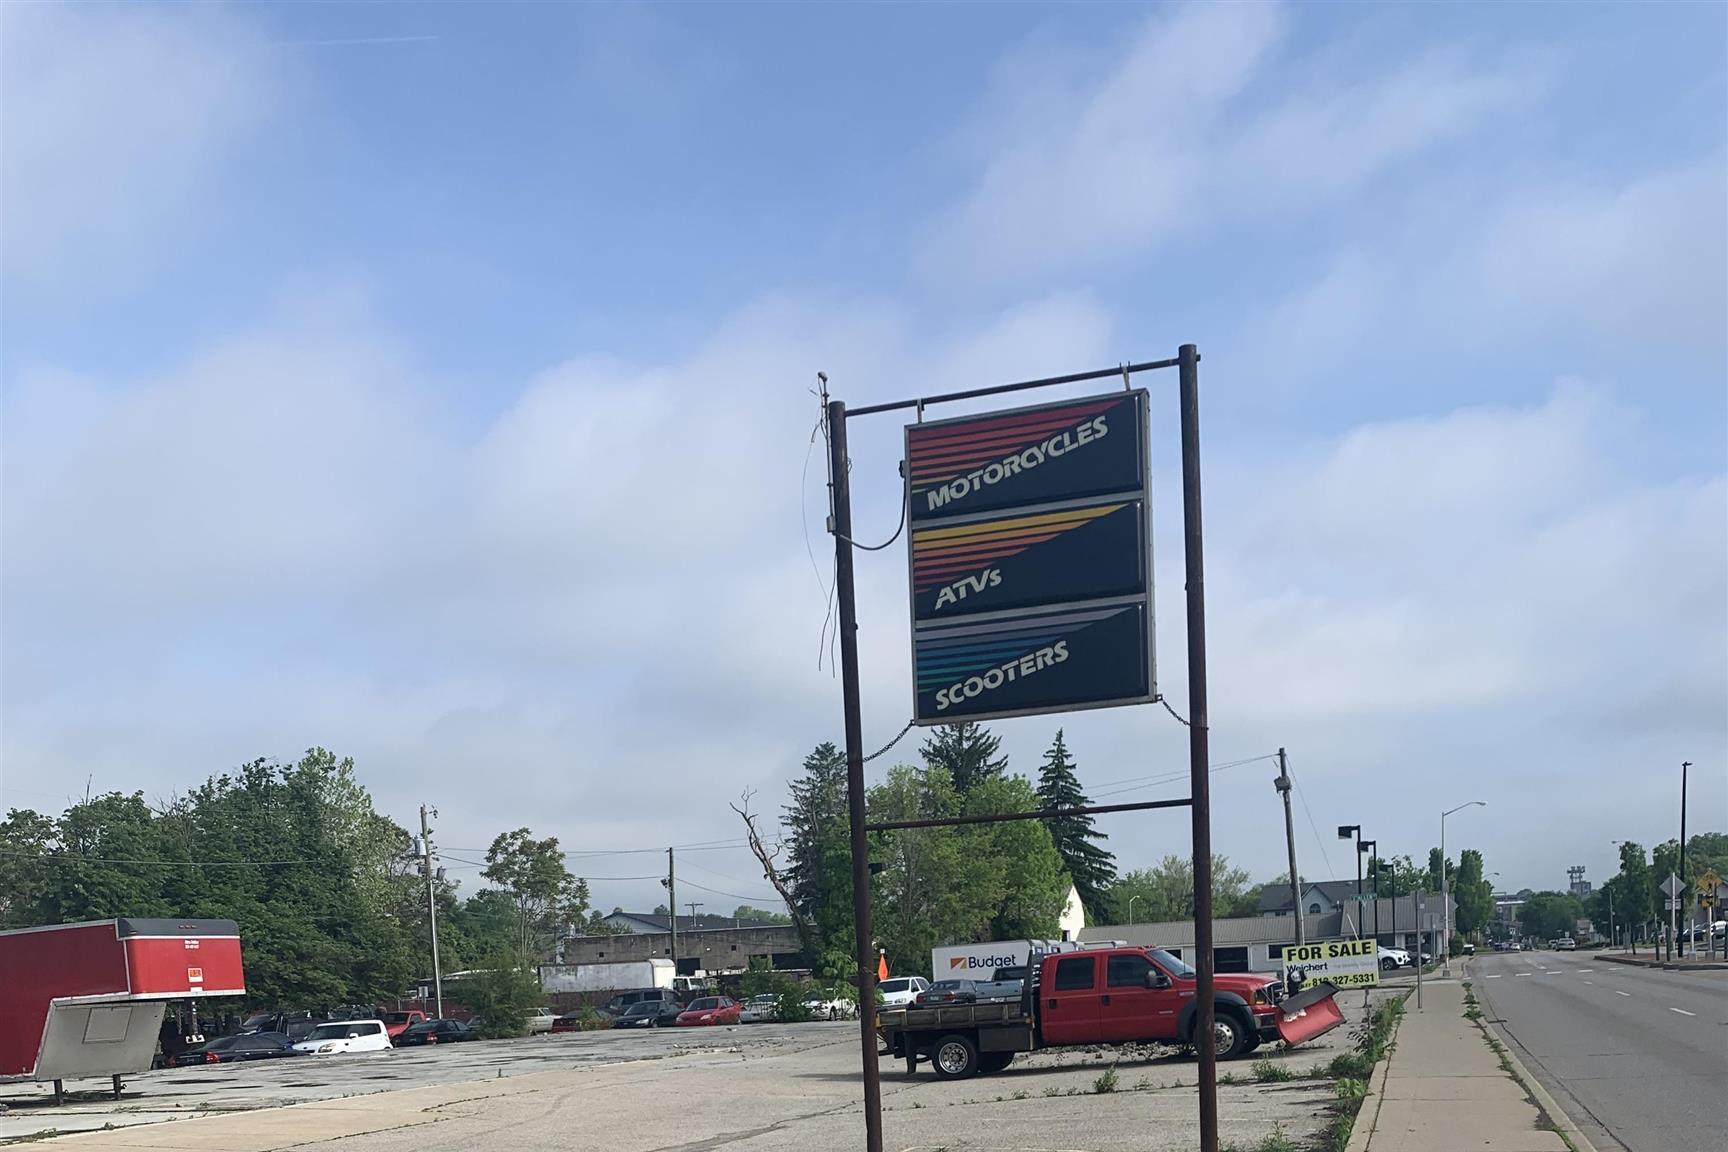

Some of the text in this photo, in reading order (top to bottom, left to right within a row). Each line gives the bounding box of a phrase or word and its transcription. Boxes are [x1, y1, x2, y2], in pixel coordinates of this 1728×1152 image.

[927, 415, 1109, 512] MOTORCYCLES
[934, 568, 1003, 611] ATVs
[935, 640, 1070, 711] SCOOTERS
[968, 954, 1016, 968] Budget
[1287, 941, 1371, 961] FOR SALE
